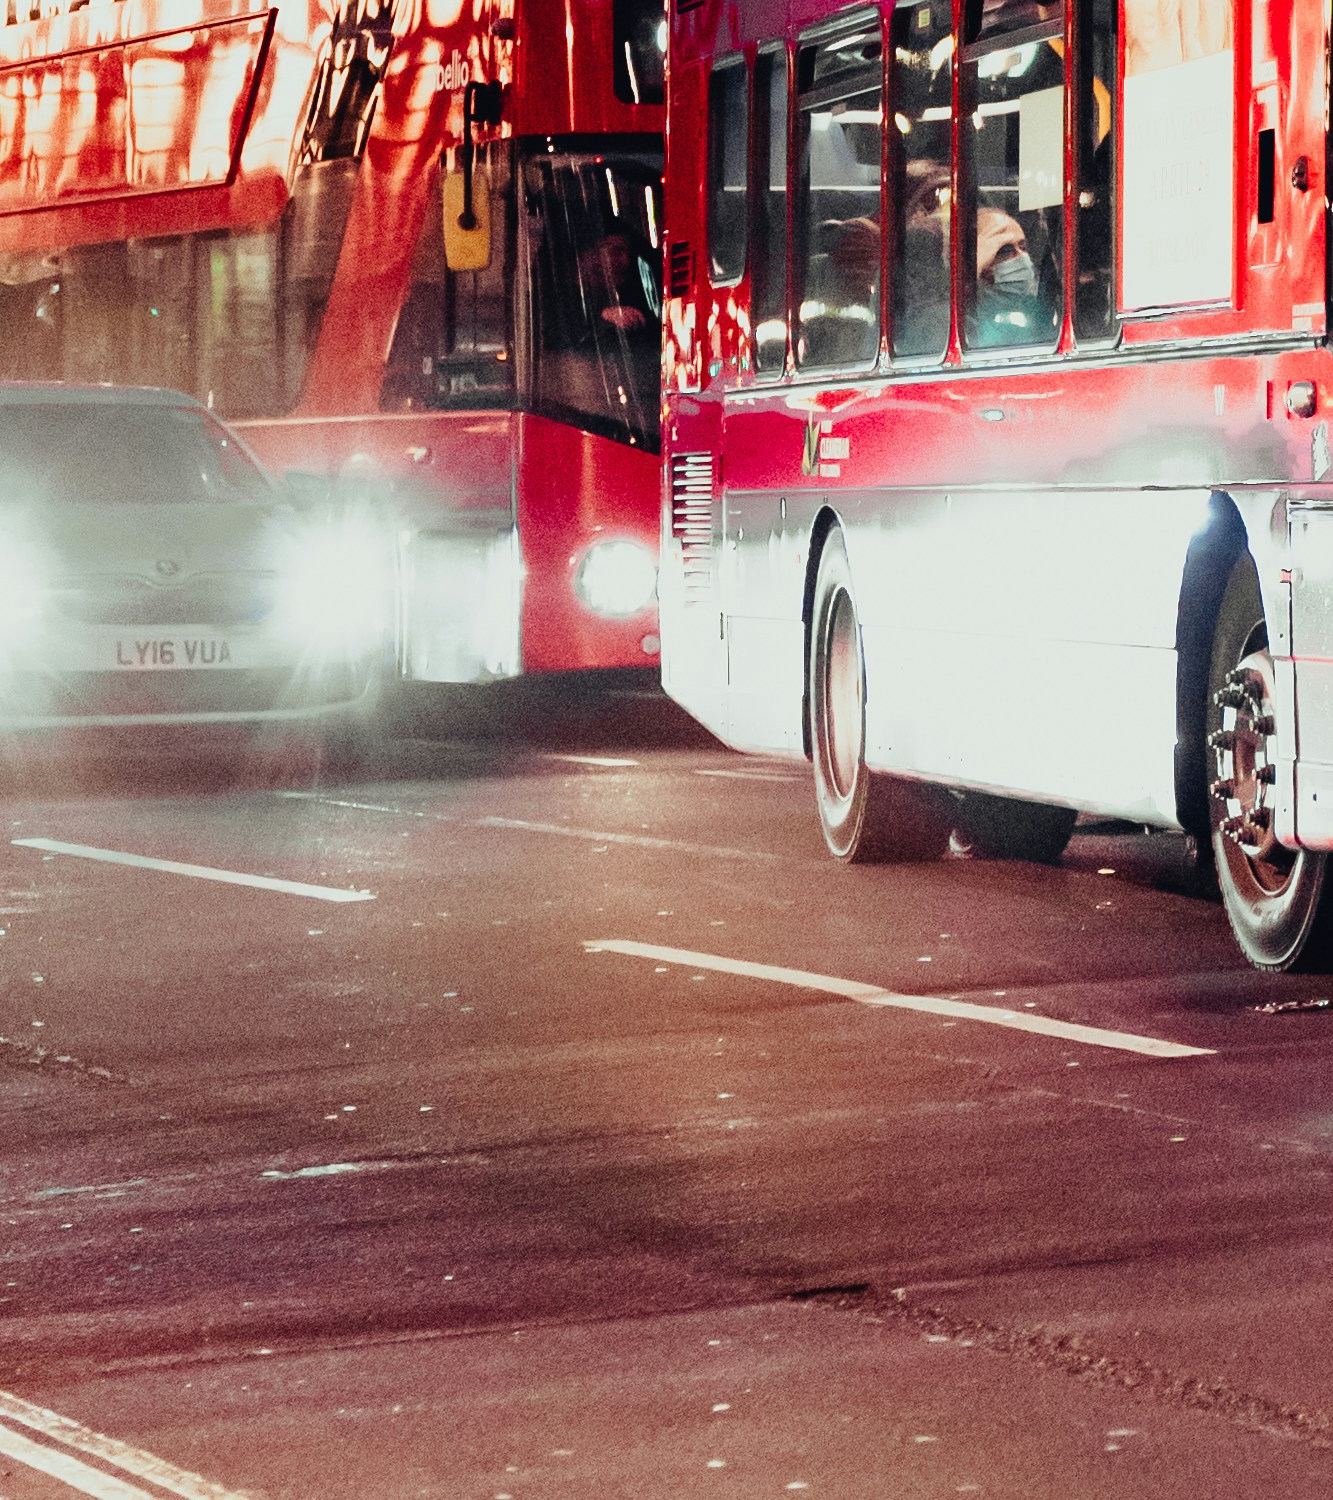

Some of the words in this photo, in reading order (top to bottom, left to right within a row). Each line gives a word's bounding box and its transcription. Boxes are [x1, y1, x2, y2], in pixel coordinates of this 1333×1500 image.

[435, 49, 469, 92] bellio
[117, 640, 175, 665] LY16
[184, 640, 231, 665] VUA
